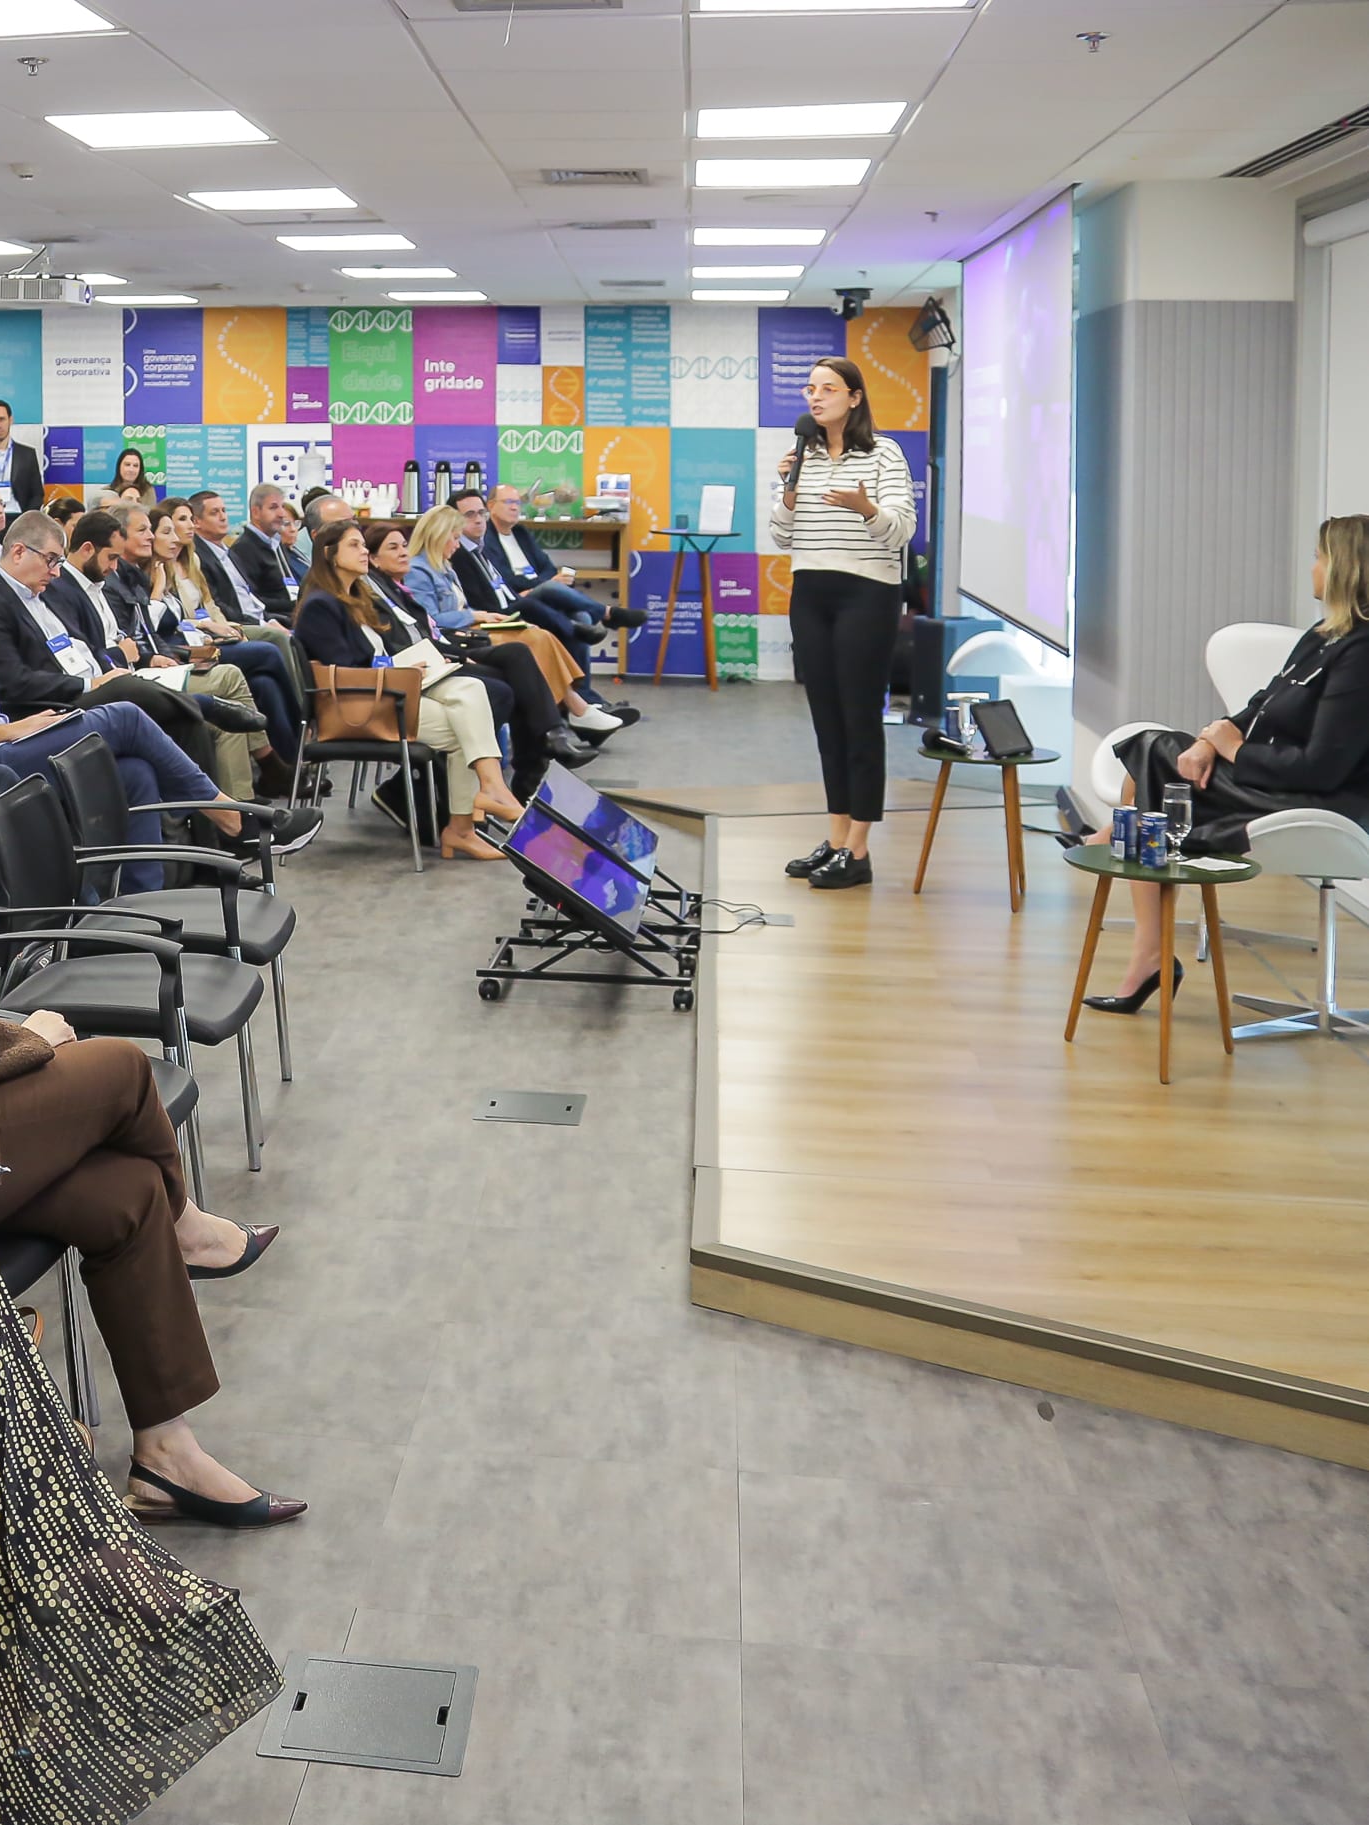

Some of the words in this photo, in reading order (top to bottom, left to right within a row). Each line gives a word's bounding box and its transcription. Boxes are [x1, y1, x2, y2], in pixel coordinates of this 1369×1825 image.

[143, 354, 197, 364] governança
[342, 340, 396, 366] Equi
[55, 356, 111, 366] governança
[424, 359, 456, 373] Inte
[56, 367, 111, 377] corporativa
[143, 364, 195, 373] corporativa
[342, 371, 403, 391] dade
[424, 376, 484, 392] gridade
